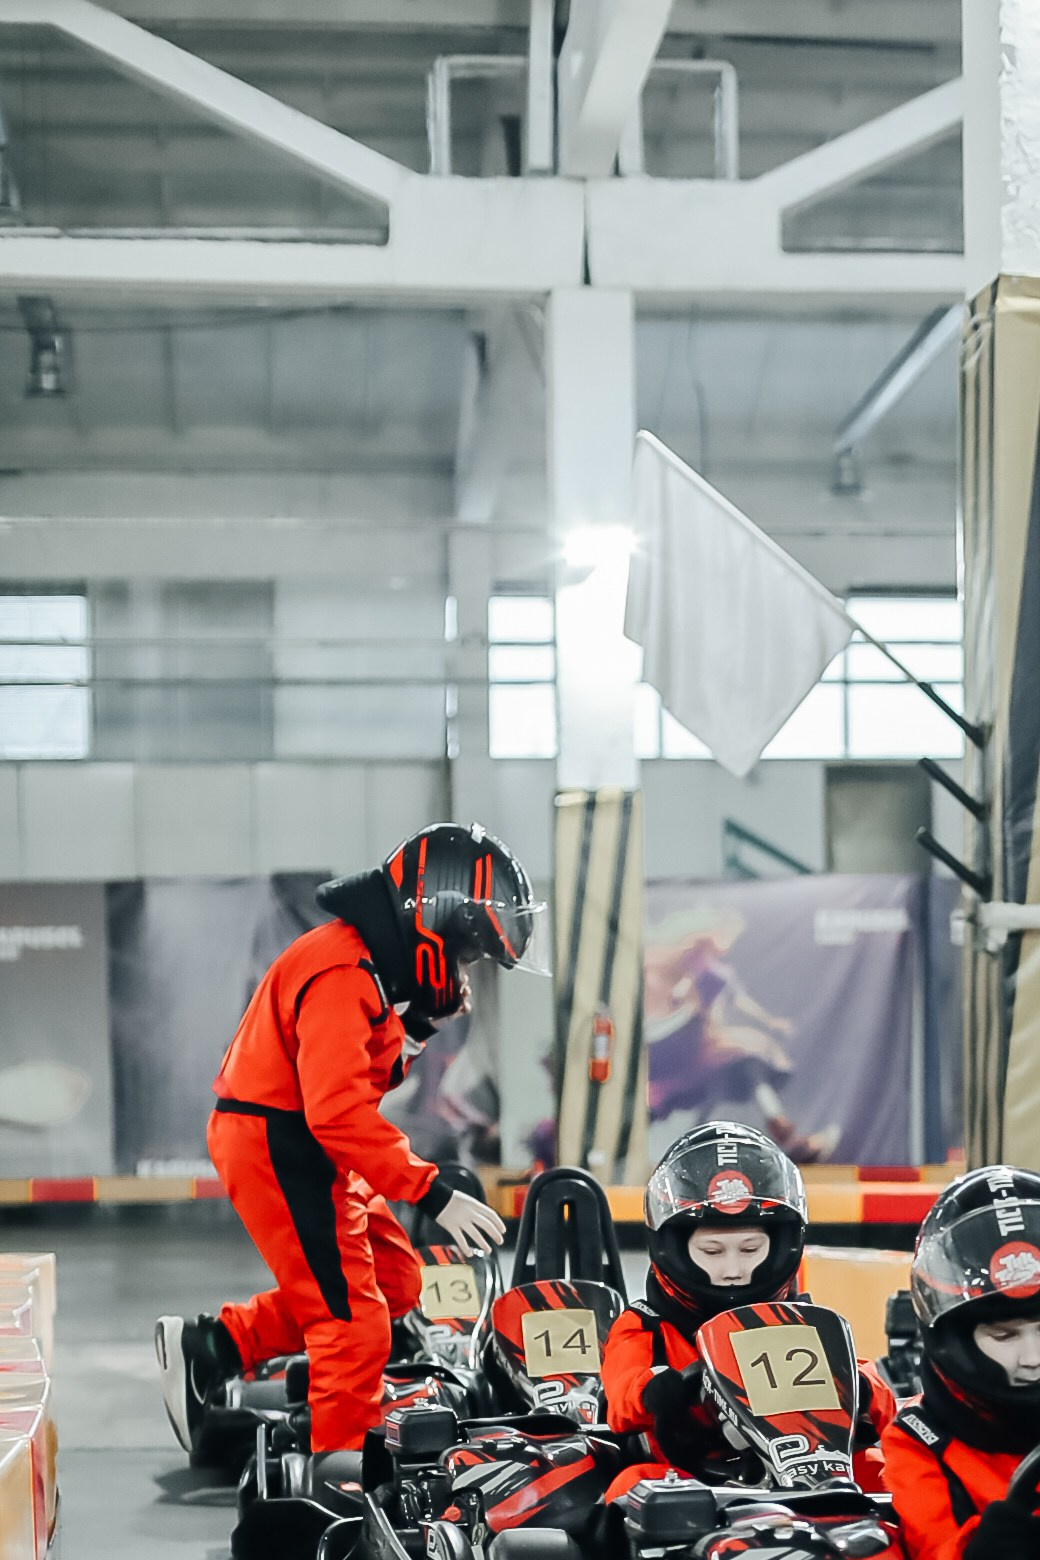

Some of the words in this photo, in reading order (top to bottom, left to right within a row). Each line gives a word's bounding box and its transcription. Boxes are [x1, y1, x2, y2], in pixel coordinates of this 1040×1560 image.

[426, 1279, 472, 1304] 13
[533, 1327, 592, 1358] 14
[750, 1347, 826, 1389] 12
